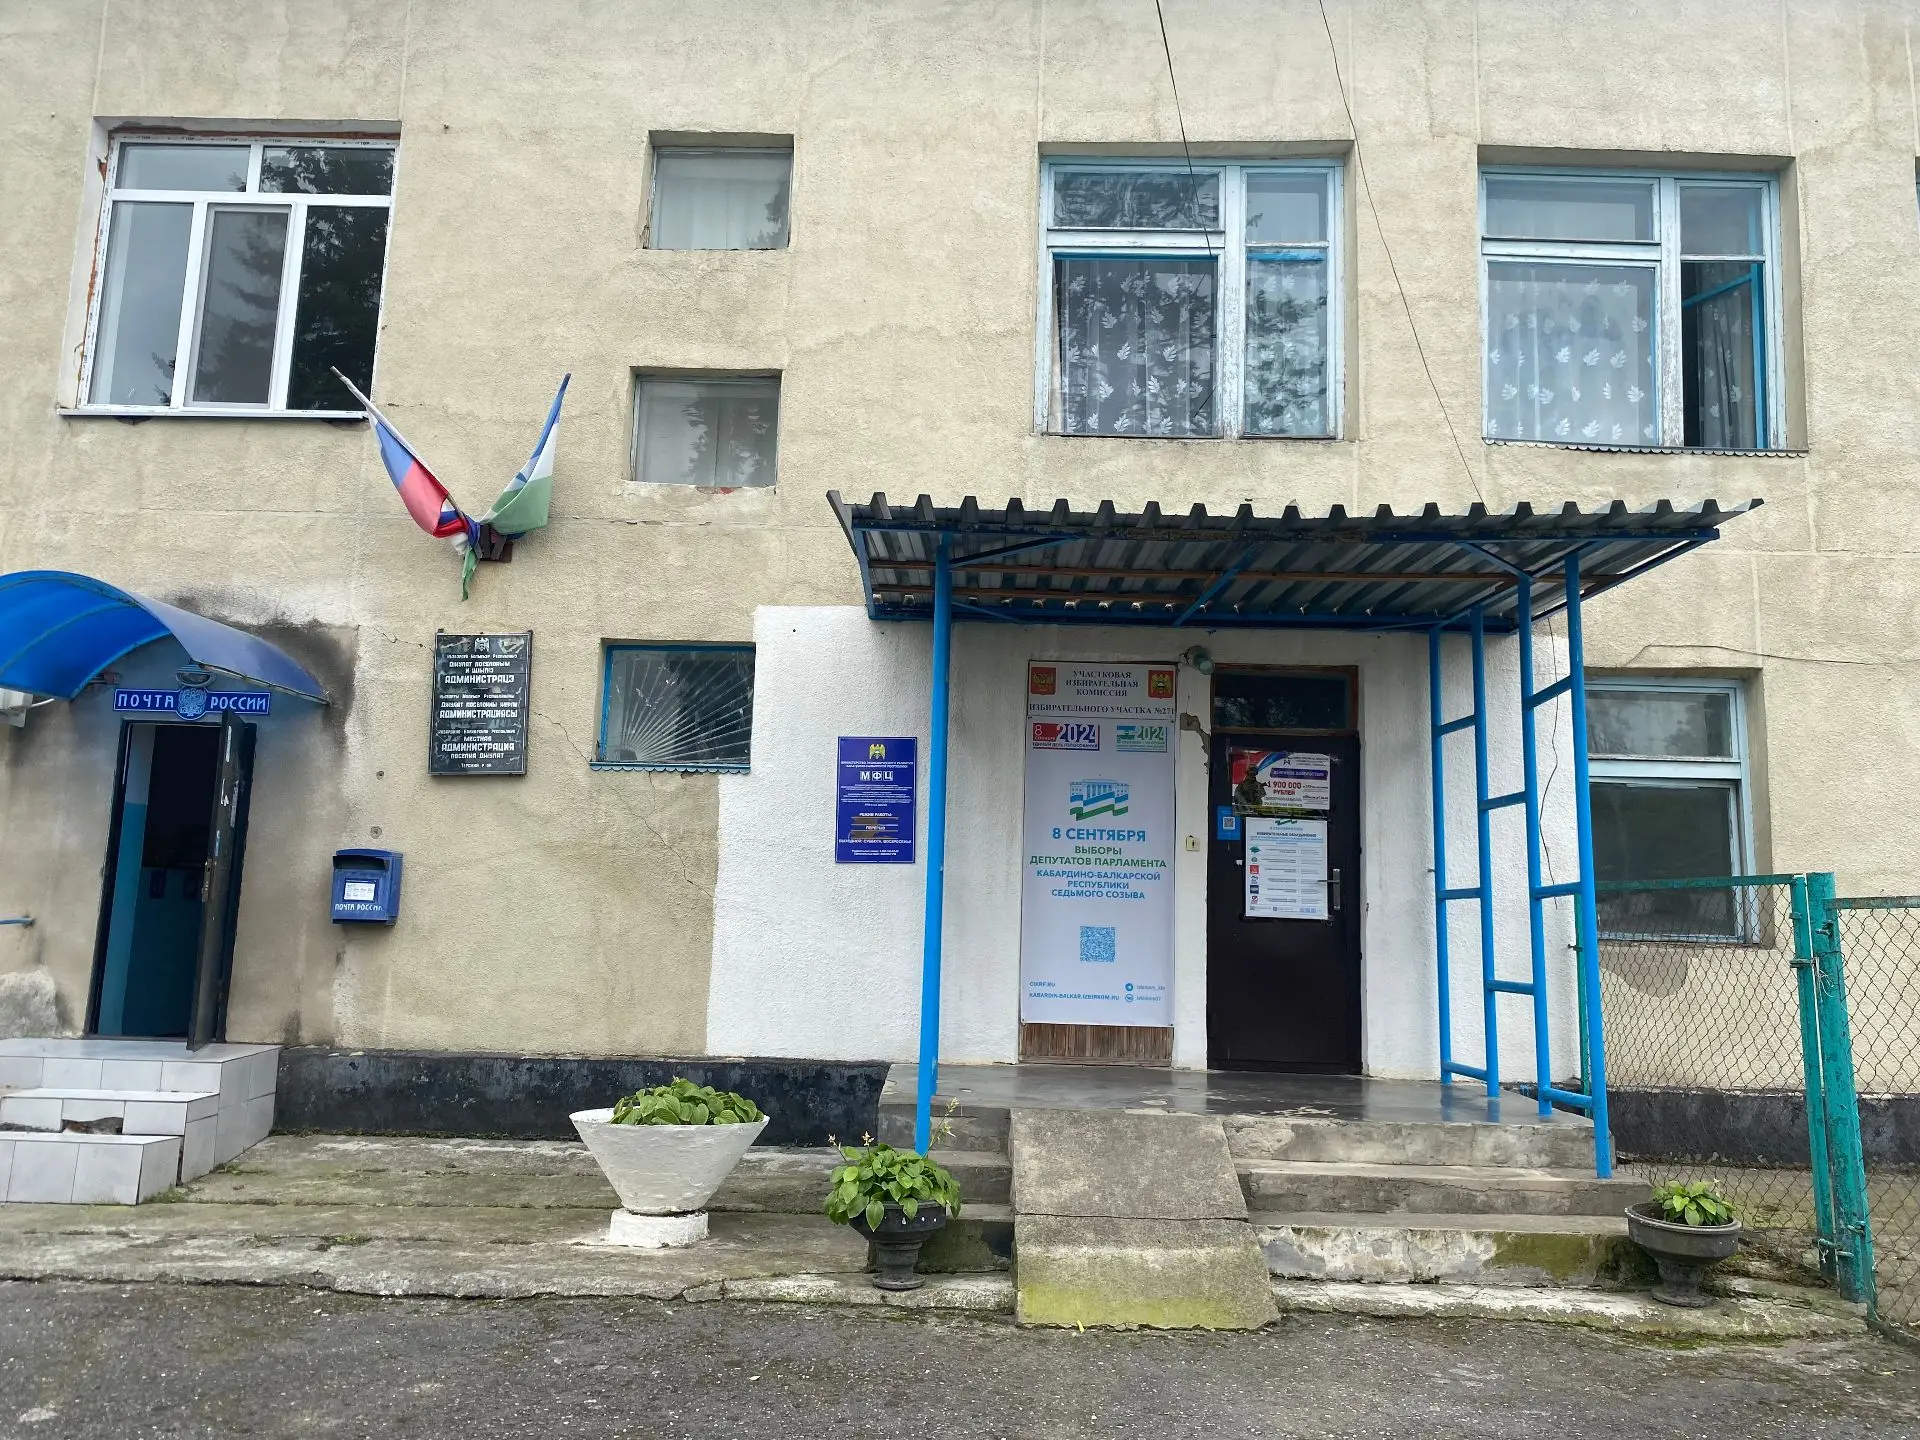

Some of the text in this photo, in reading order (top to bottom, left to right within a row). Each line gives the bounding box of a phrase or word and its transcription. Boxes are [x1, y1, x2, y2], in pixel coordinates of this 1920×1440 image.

[1073, 670, 1132, 678] УЧАСТКОВАЯ
[445, 675, 515, 684] АДМИНИСТРАЦЭ
[1066, 680, 1139, 688] ИЗБИРАТЕЛЬНАЯ
[1076, 689, 1128, 697] КОМИССИЯ
[118, 694, 266, 710] ПОЧТА РОССИИ
[440, 710, 518, 718] АДМИНИСТРАЦИЯСЫ
[1030, 704, 1174, 715] ИЗБИРАТЕЛЬНОГО УЧАСТКА №271
[1035, 725, 1042, 736] 8
[1056, 724, 1096, 743] 2024
[1137, 726, 1164, 740] 2024
[442, 743, 514, 752] АДМИНИСТРАЦИЯ
[861, 771, 893, 780] МФЦ
[1052, 828, 1146, 842] 8 СЕНТЯБРЯ
[1075, 846, 1122, 855] ВЫБОРЫ
[1030, 856, 1167, 868] ДЕПУТАТОВ ПАРЛАМЕНТА
[1036, 870, 1160, 881] КАБАРДИНО-БАЛКАРСКОЙ
[1068, 881, 1129, 889] РЕСПУБЛИКИ
[1052, 889, 1145, 899] СЕДЬМОГО СОЗЫВА
